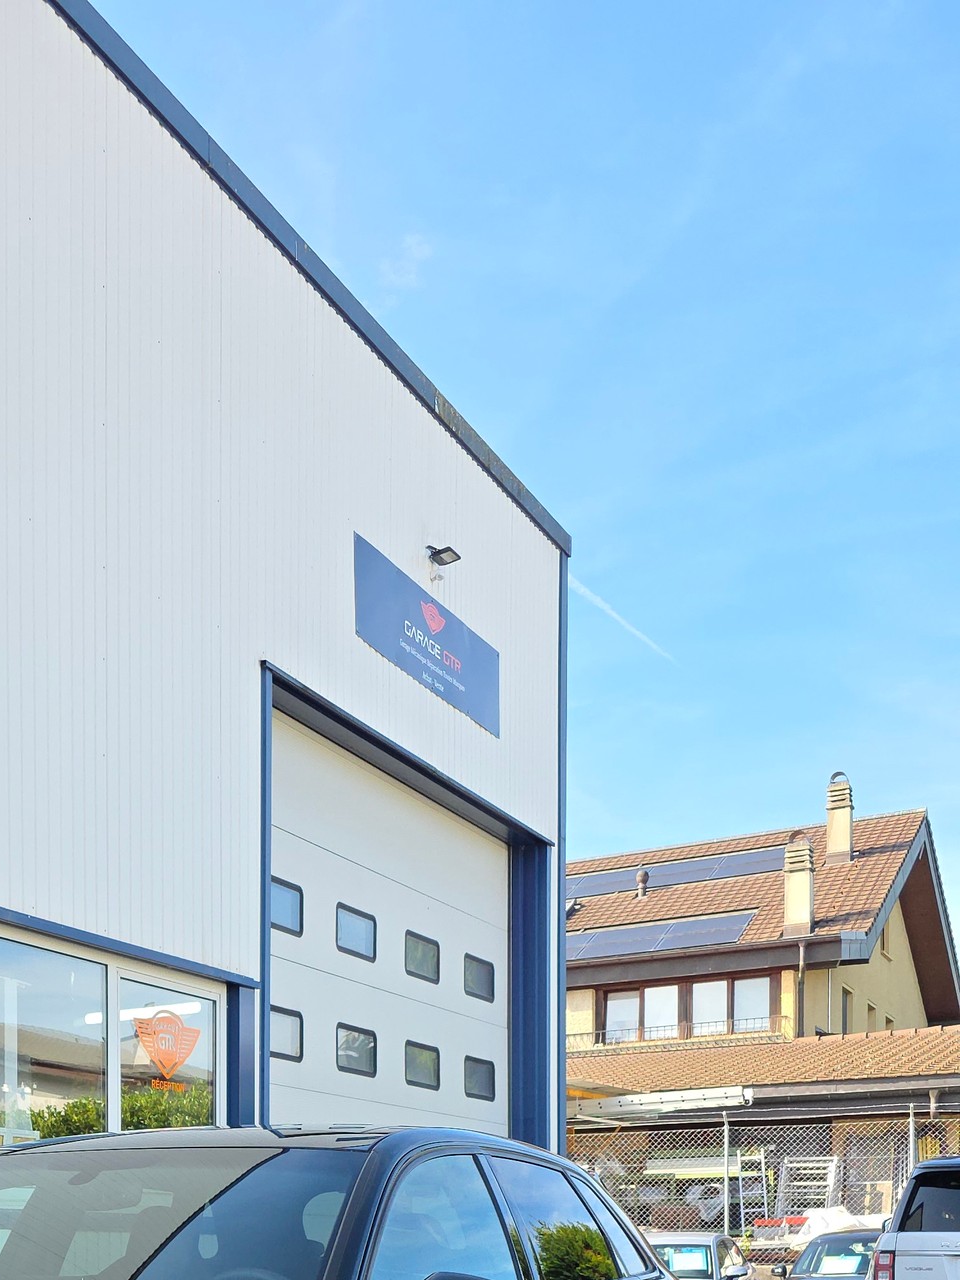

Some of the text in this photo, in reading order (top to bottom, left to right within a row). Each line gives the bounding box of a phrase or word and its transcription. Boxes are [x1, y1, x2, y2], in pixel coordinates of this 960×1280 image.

[404, 620, 441, 660] GARAGE
[443, 650, 461, 674] GTR
[158, 1033, 176, 1052] GTR
[151, 1078, 186, 1093] RÉCEPTION
